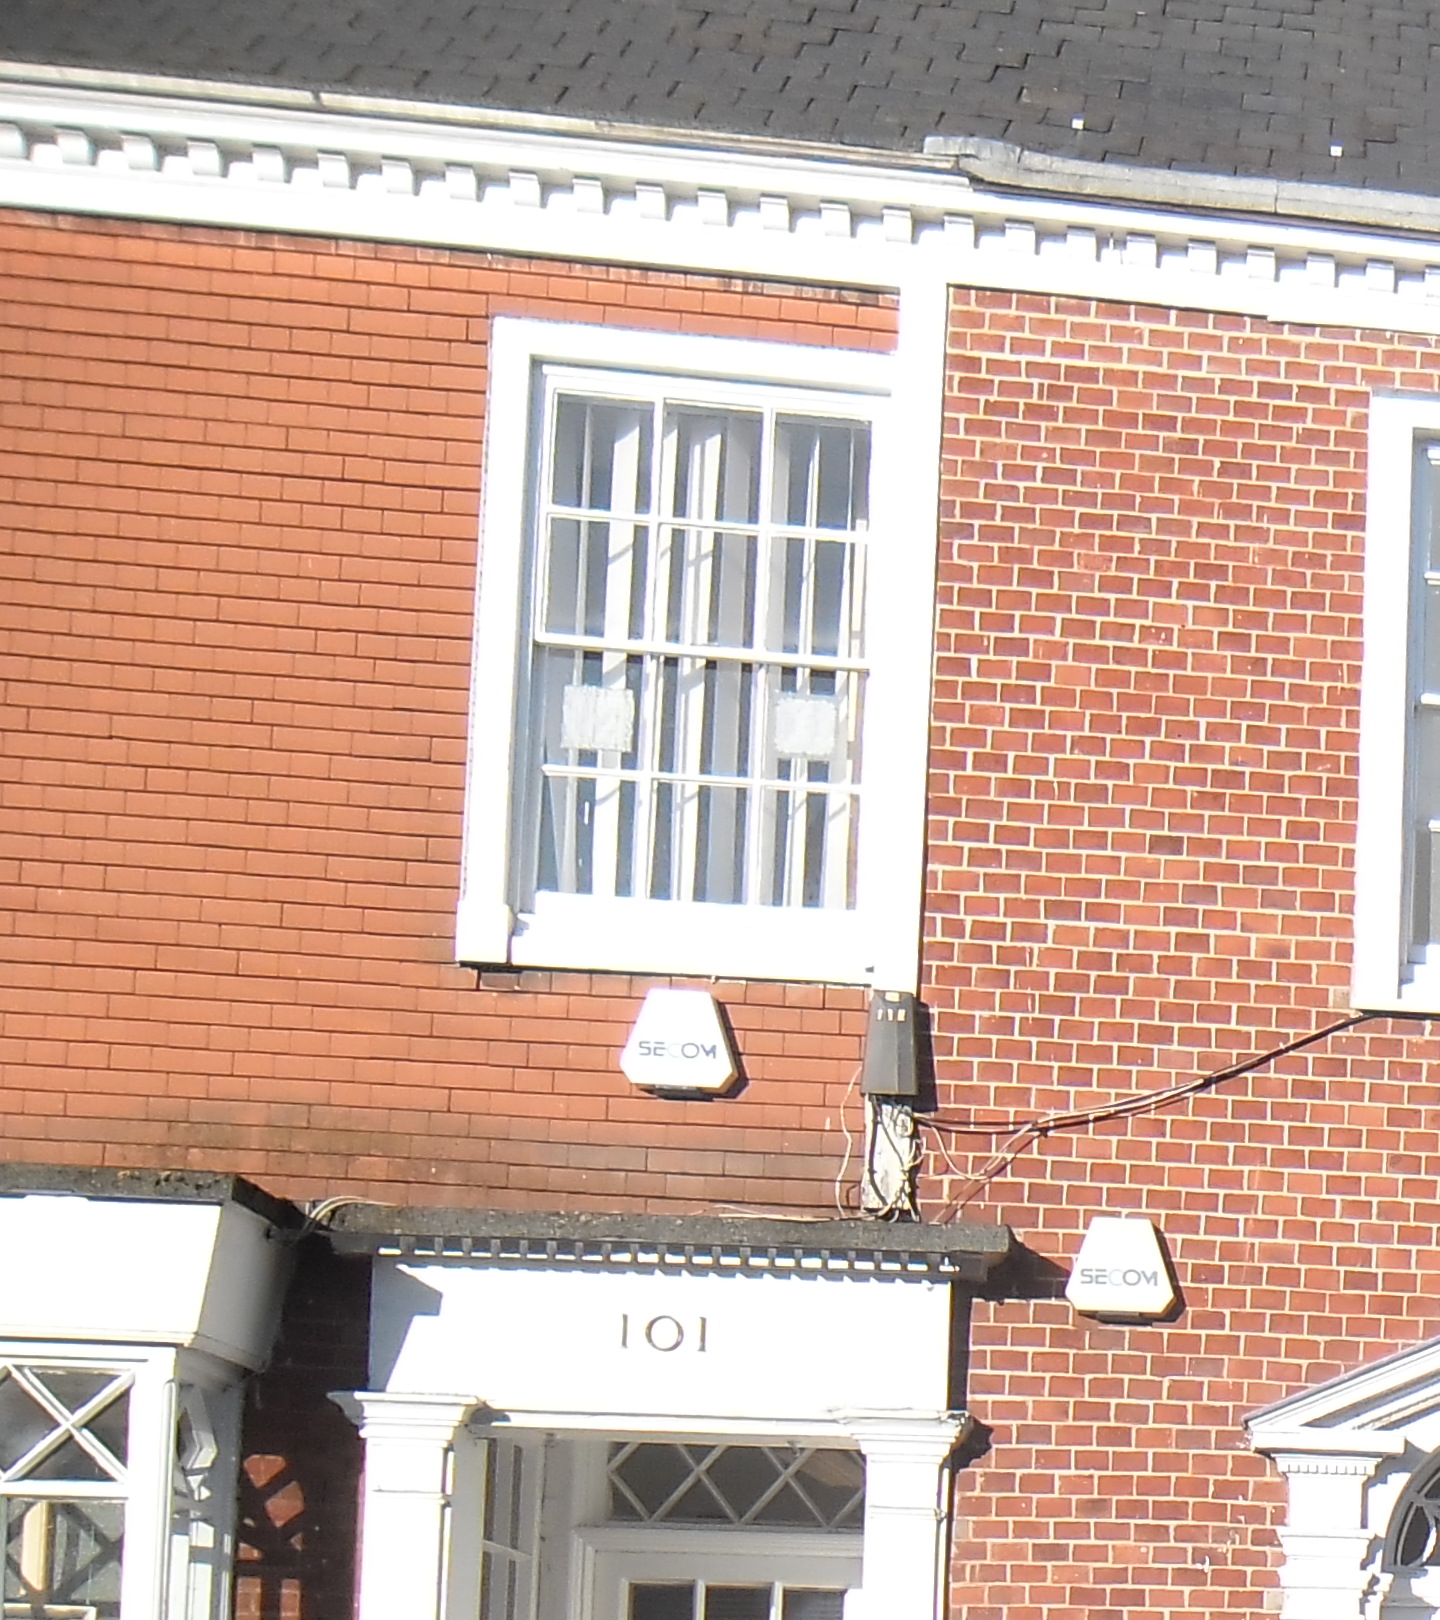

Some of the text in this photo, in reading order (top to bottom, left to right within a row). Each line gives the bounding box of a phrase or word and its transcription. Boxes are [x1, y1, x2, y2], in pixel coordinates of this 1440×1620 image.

[638, 1040, 717, 1060] SECOM
[1080, 1268, 1158, 1287] SECOM
[621, 1313, 707, 1352] 101
